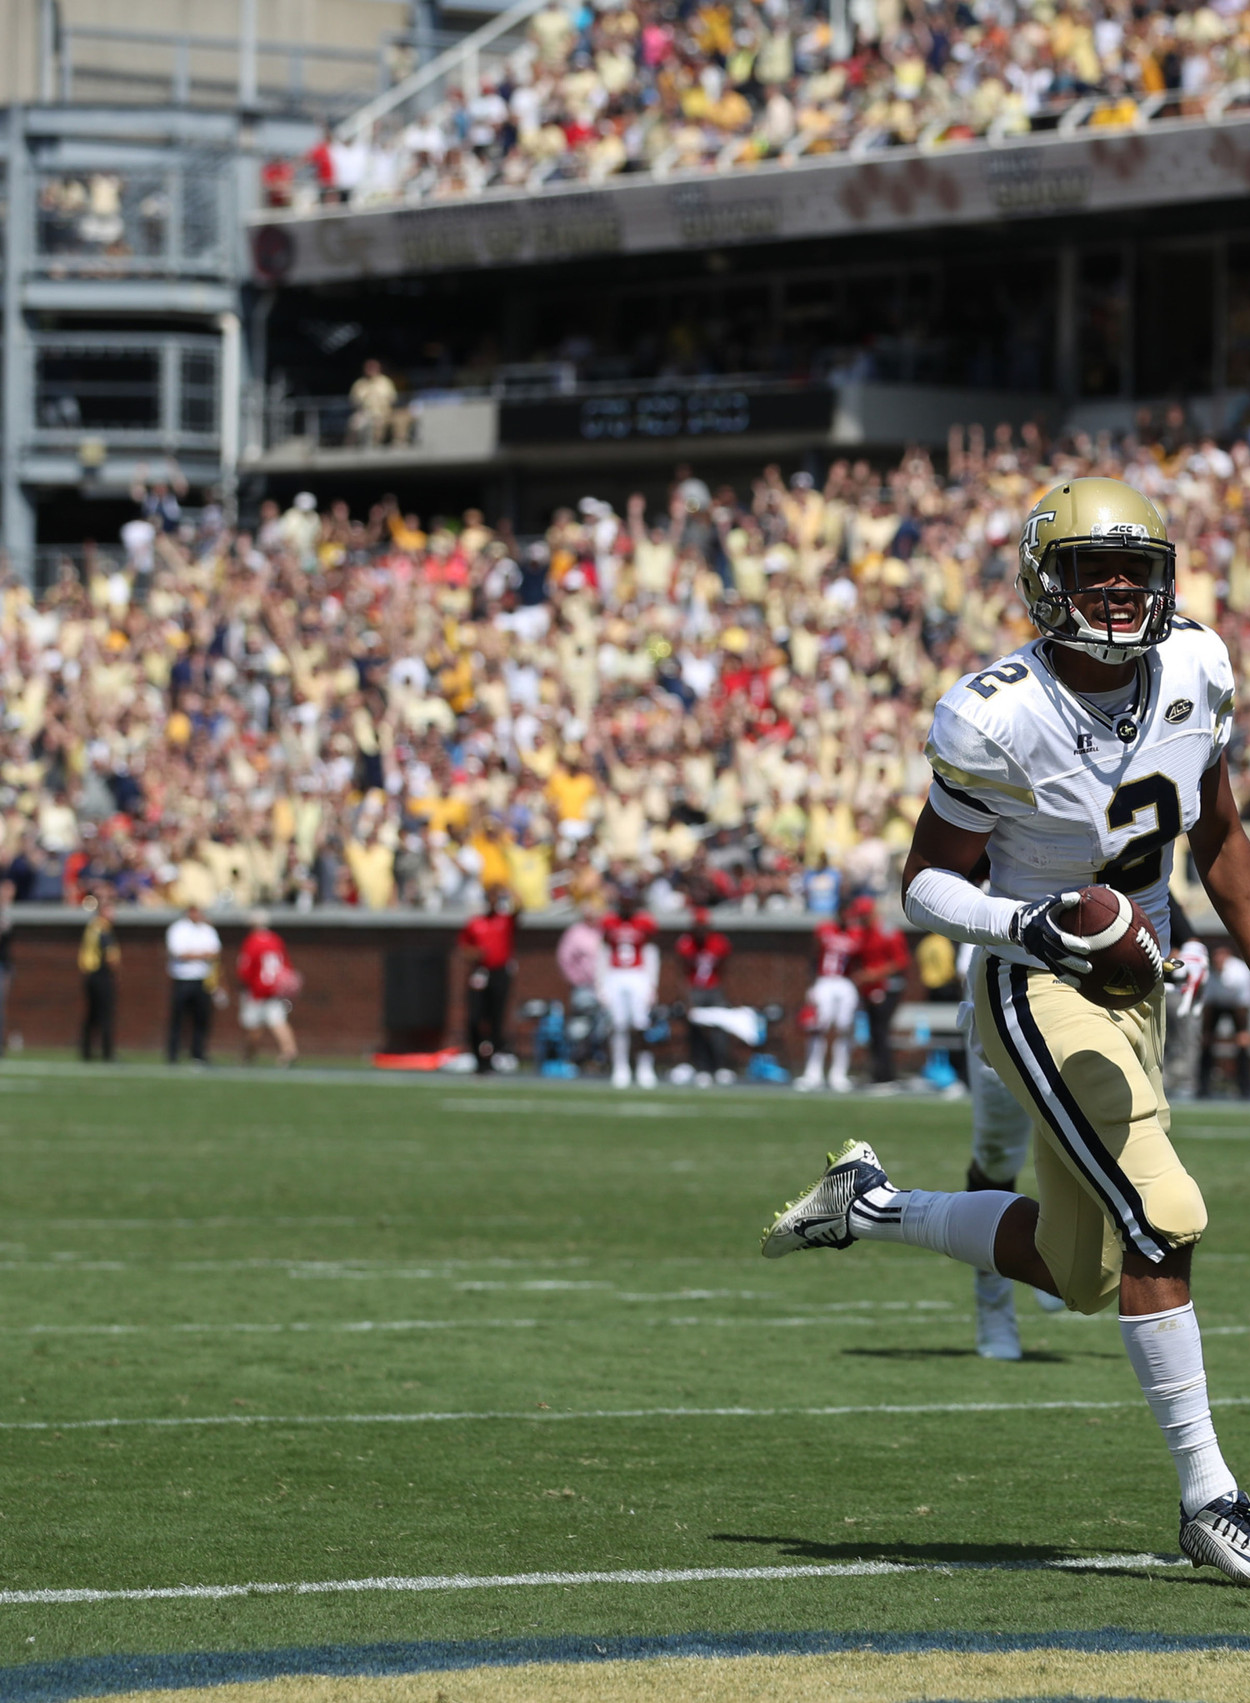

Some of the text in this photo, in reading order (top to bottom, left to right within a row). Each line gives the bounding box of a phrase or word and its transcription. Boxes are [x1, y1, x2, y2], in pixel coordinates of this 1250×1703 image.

[1109, 524, 1133, 533] ACC
[965, 661, 1031, 701] 2
[1168, 700, 1191, 718] ACC
[1093, 770, 1183, 896] 2
